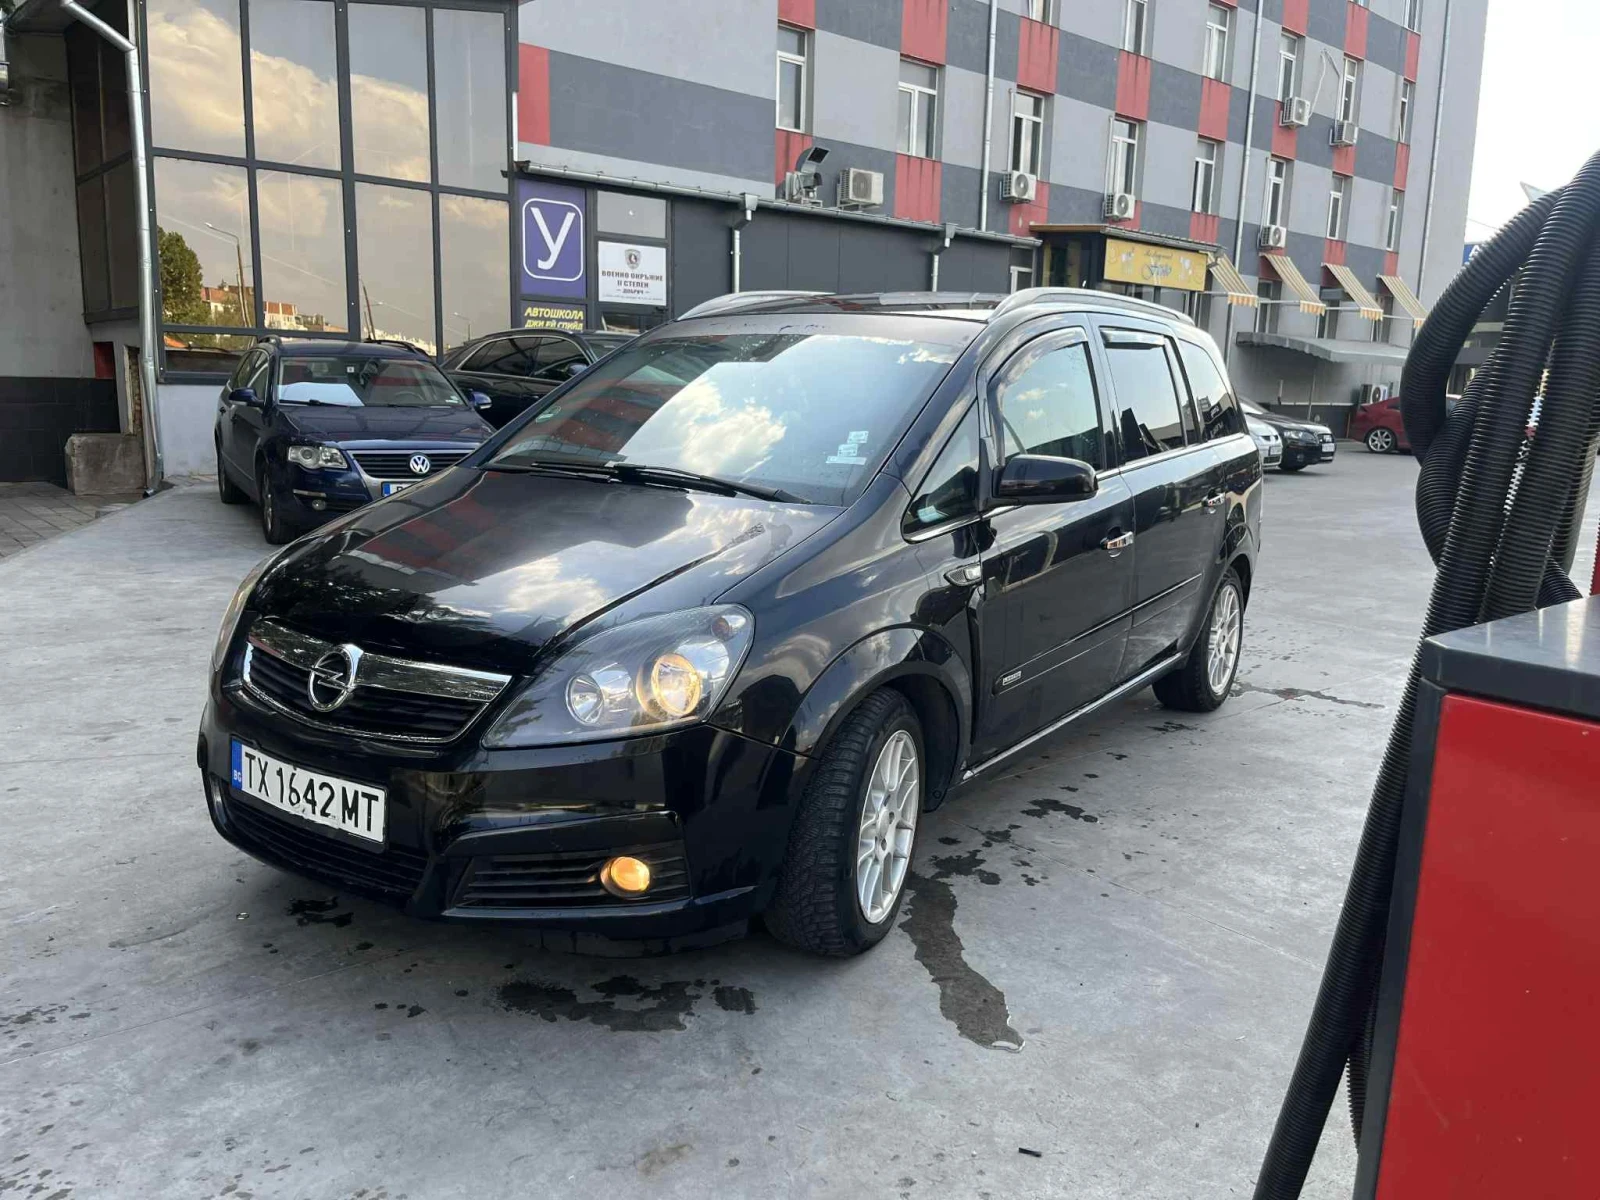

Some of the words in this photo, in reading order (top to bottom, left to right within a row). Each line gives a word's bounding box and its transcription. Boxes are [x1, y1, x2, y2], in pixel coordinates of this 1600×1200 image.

[601, 270, 629, 279] ВОЕННО
[624, 280, 649, 288] СТЕПЕН
[525, 307, 584, 320] АВТОШКОЛА
[525, 319, 544, 329] ДЖИ
[233, 770, 242, 782] BG
